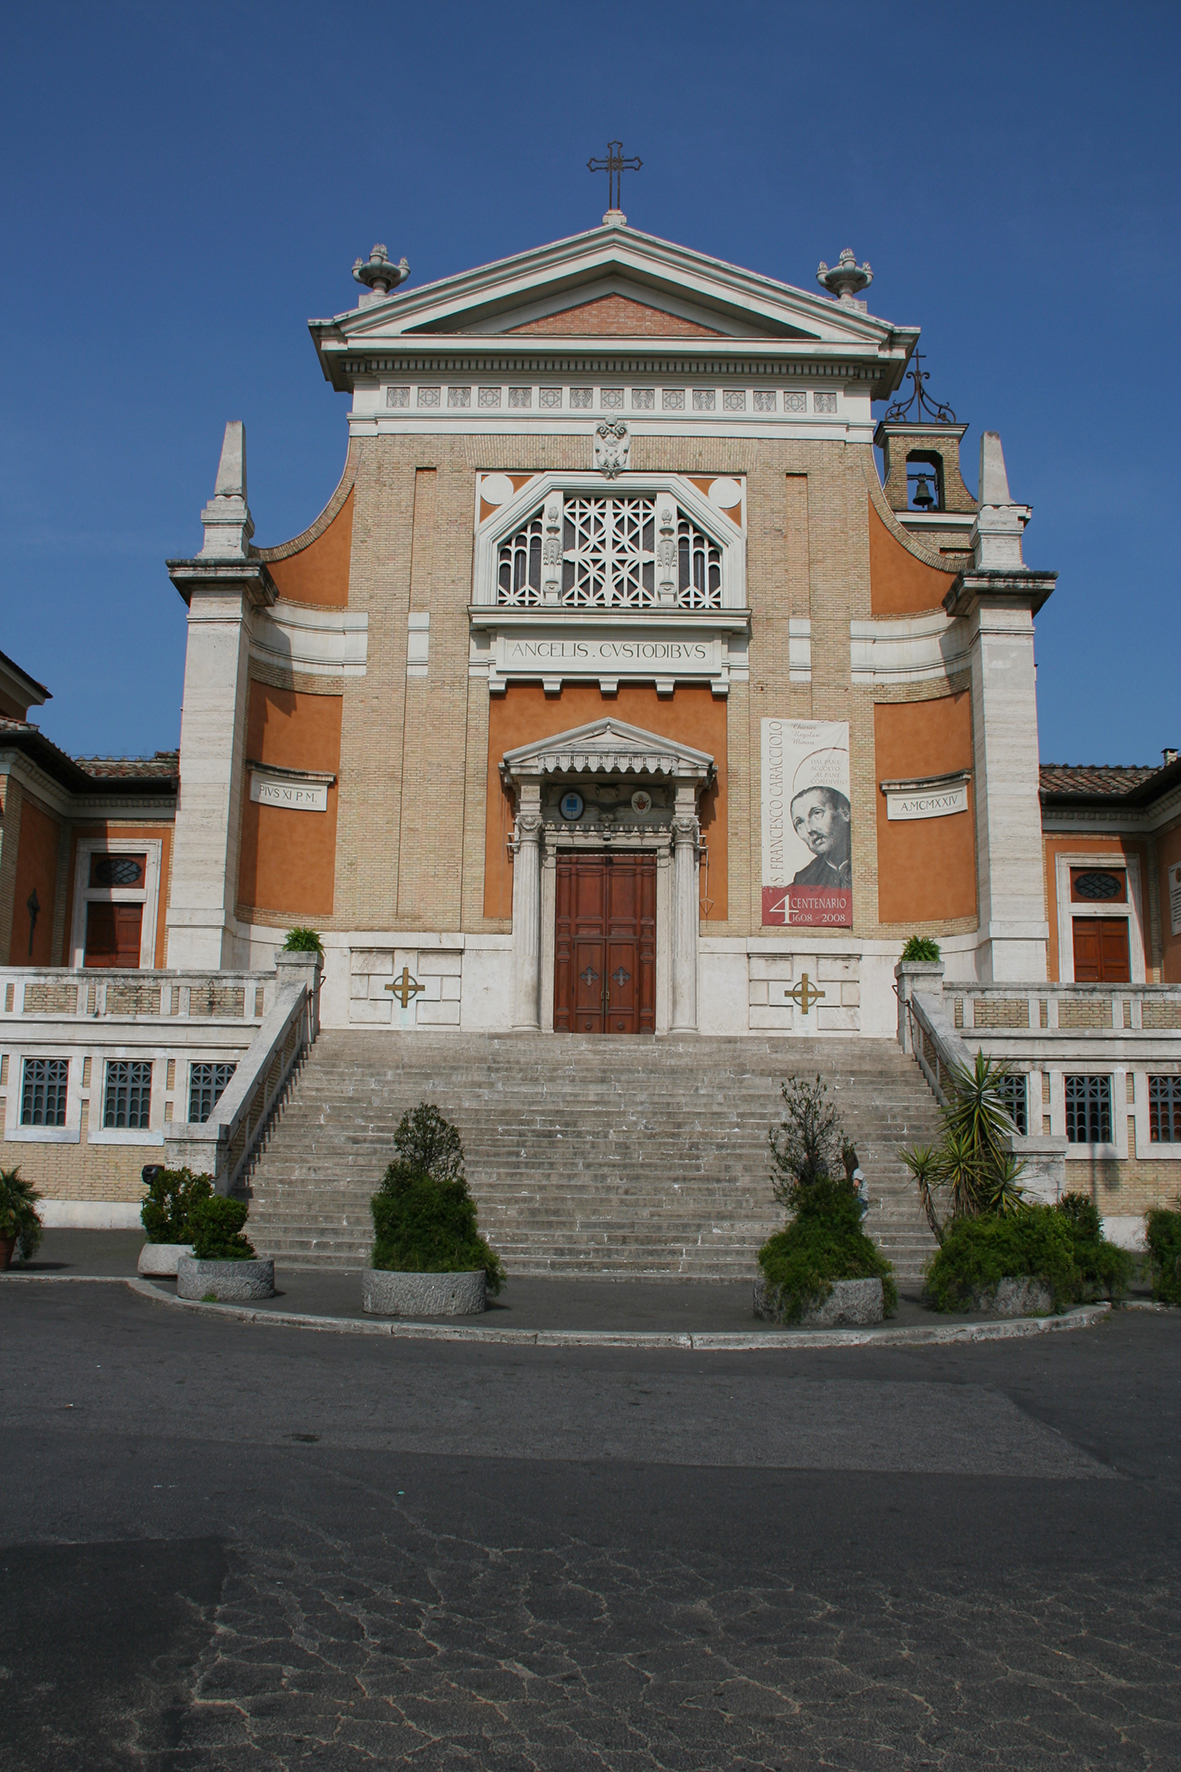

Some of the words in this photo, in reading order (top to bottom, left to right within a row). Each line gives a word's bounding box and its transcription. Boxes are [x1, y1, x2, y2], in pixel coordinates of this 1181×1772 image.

[599, 643, 706, 659] CVSTODIBVS
[768, 720, 783, 797] CARACCIOLO
[259, 784, 280, 799] PIVS
[282, 789, 292, 800] XI
[769, 799, 784, 870] FRANCESCO
[768, 894, 799, 924] 4
[790, 897, 847, 909] CENTENARIO
[792, 913, 812, 922] 1608
[822, 913, 846, 923] 2008
